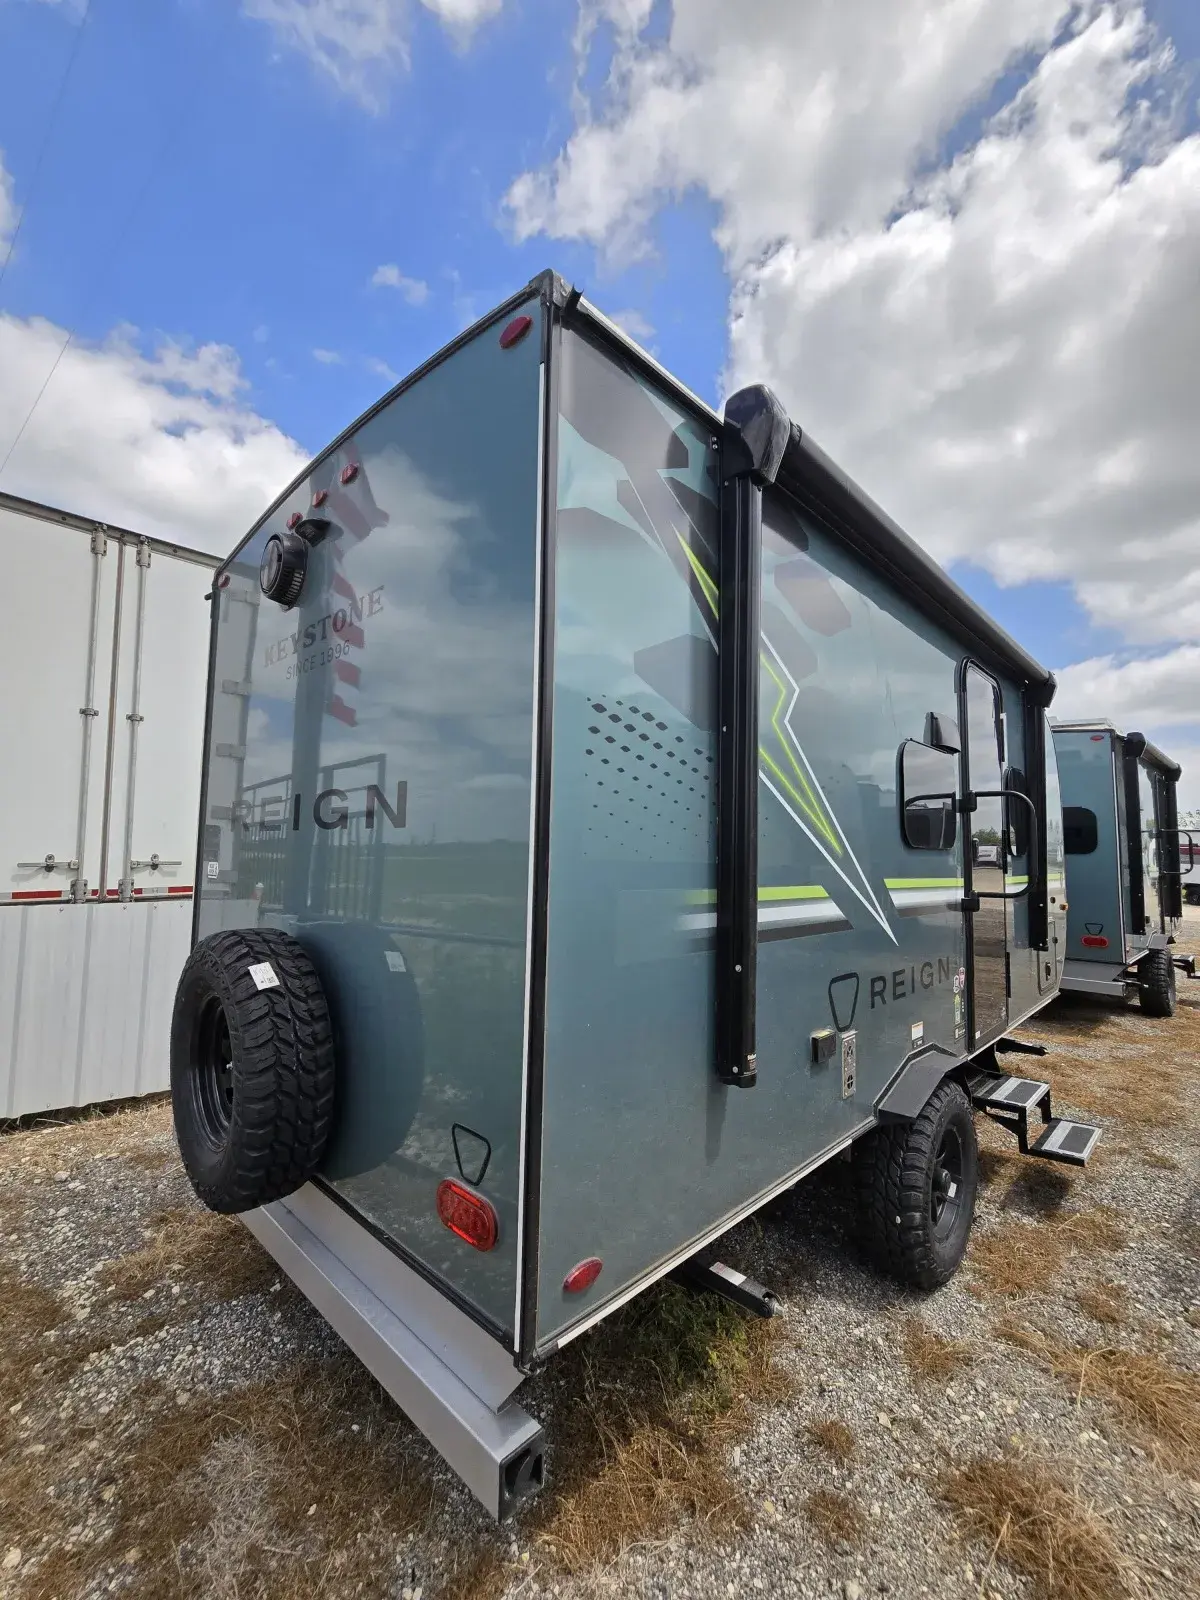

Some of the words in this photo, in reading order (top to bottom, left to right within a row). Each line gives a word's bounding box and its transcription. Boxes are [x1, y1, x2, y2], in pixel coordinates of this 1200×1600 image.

[264, 585, 385, 668] KEYSTONE
[285, 655, 317, 680] SINCE
[319, 639, 350, 667] 1996
[231, 780, 408, 832] REIGN
[869, 956, 950, 1010] REIGN
